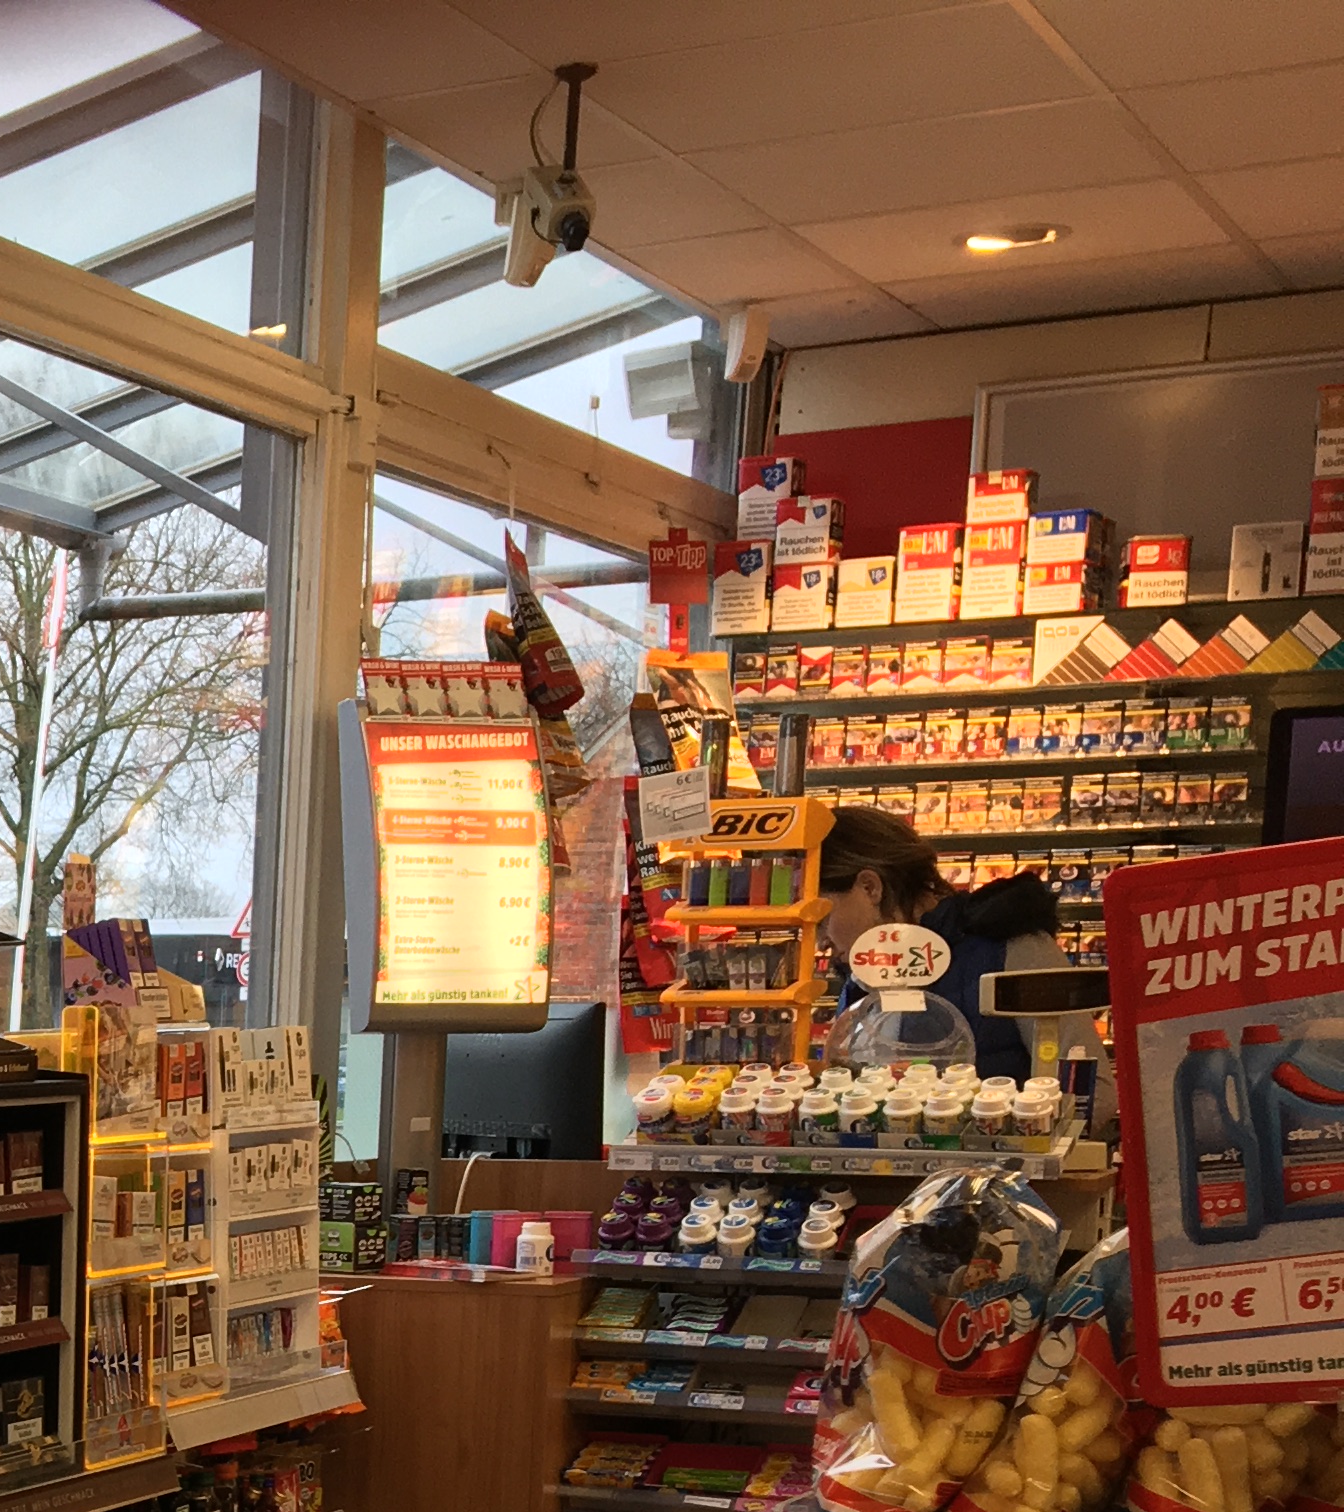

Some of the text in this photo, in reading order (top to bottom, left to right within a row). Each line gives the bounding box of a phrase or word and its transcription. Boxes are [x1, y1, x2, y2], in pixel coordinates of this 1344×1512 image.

[780, 534, 824, 546] Rauchen
[777, 545, 826, 557] ist tödlich
[1134, 578, 1185, 588] Rauchen
[1129, 588, 1187, 600] ist tödlich
[380, 732, 529, 751] UNSER WASCHANGEBOT
[487, 779, 516, 790] 11,90
[496, 817, 520, 829] 9,90
[520, 817, 529, 829] €
[498, 856, 523, 869] 8,90
[523, 856, 531, 868] €
[499, 897, 523, 908] 6,90
[523, 897, 531, 908] €
[878, 930, 901, 943] 3 €
[853, 948, 904, 967] star
[1144, 926, 1344, 998] ZUM STA
[879, 968, 889, 980] 2
[382, 987, 509, 1002] Mehr als günstig tanken!
[1288, 1127, 1322, 1141] star
[355, 1195, 381, 1208] OCB
[358, 1238, 385, 1251] OCB
[1166, 1290, 1224, 1328] 4,00
[1230, 1287, 1257, 1318] €
[1169, 1357, 1313, 1380] Mehr als günstig
